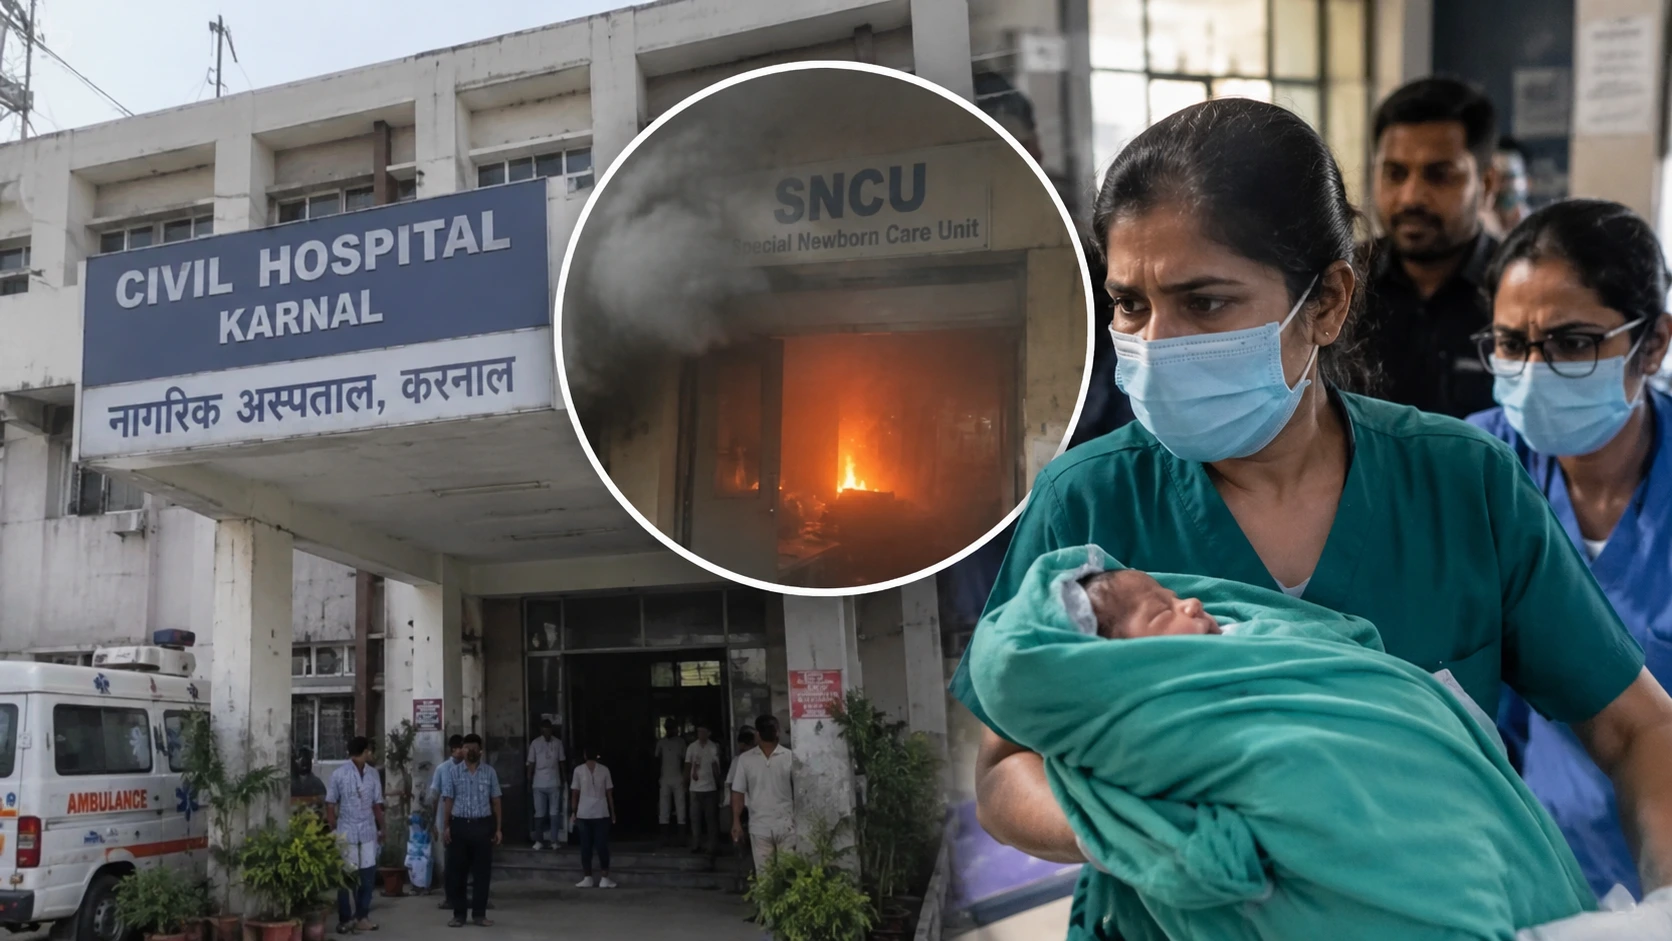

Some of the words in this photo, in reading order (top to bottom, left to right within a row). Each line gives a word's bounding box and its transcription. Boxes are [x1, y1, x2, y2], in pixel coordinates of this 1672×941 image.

[774, 162, 926, 225] SNCU
[115, 257, 233, 308] CIVIL
[258, 210, 511, 287] HOSPITAL
[732, 234, 792, 255] Special
[798, 230, 879, 251] Newborn
[886, 224, 931, 244] Care
[938, 218, 979, 240] Unit
[219, 289, 384, 344] KARNAL
[108, 386, 223, 438] नागरिक
[237, 374, 386, 424] अस्पताल,
[400, 356, 516, 404] करनाल
[67, 789, 148, 814] AMBULANCE
